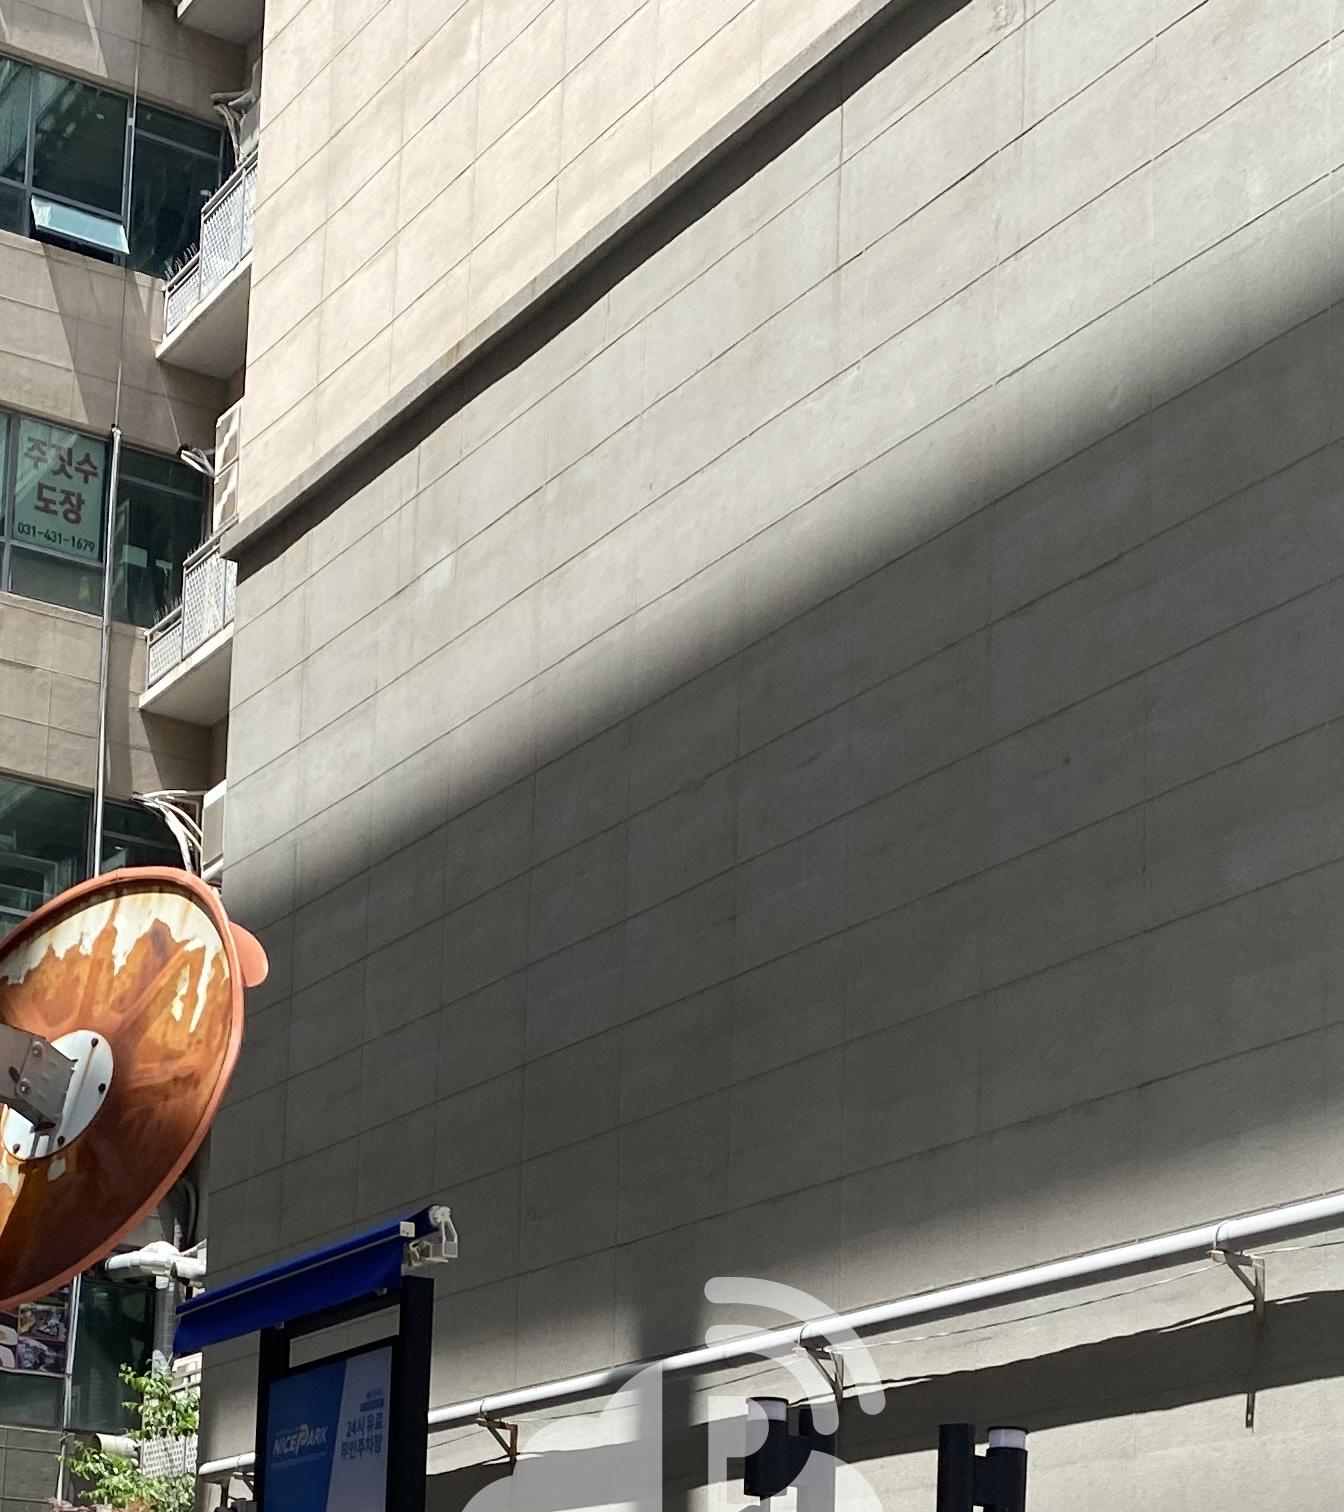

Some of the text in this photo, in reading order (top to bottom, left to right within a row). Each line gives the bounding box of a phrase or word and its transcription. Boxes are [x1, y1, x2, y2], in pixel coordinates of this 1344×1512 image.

[23, 437, 100, 485] 주짓수
[33, 481, 87, 525] 도장
[16, 521, 96, 554] 031-431-1679
